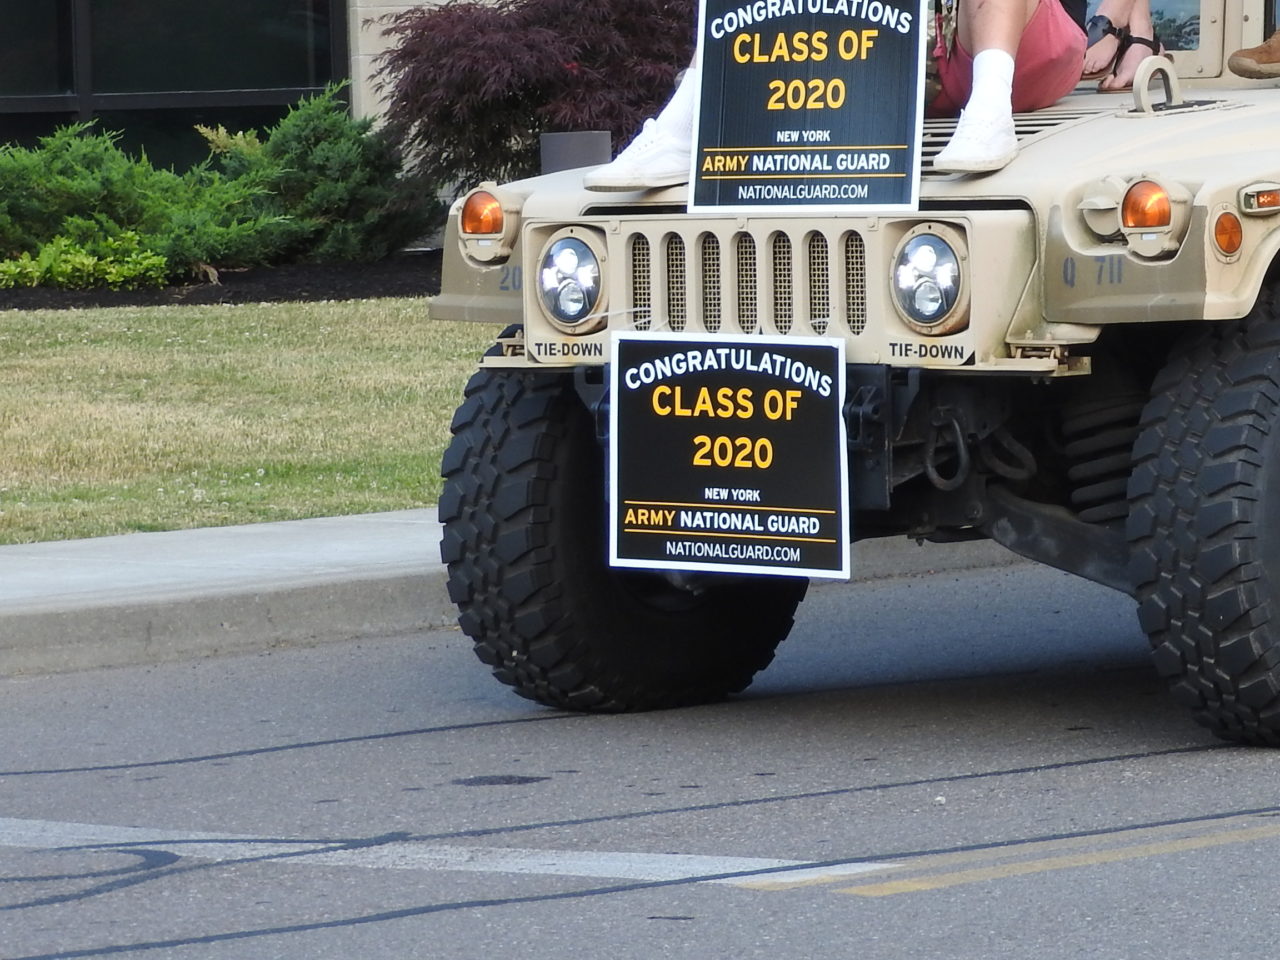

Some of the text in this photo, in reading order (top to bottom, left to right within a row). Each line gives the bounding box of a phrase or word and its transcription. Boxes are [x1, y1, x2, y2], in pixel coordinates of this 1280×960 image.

[733, 29, 878, 64] CLASS OF
[767, 78, 846, 110] 2020
[776, 130, 830, 142] NEW YORK
[702, 153, 890, 171] ARMY NATIONAL GUARD
[738, 184, 868, 199] NATIONALGUARD.COM
[535, 343, 602, 357] TIE-DOWN
[889, 343, 964, 359] TIE-DOWN
[625, 348, 832, 397] CONGRATULATIONS
[652, 385, 802, 421] CLASS OF
[692, 435, 773, 469] 2020
[704, 487, 761, 502] NEW YORK
[624, 509, 820, 534] ARMY NATIONAL GUARD
[666, 541, 800, 562] NATIONALGUARD.COM
